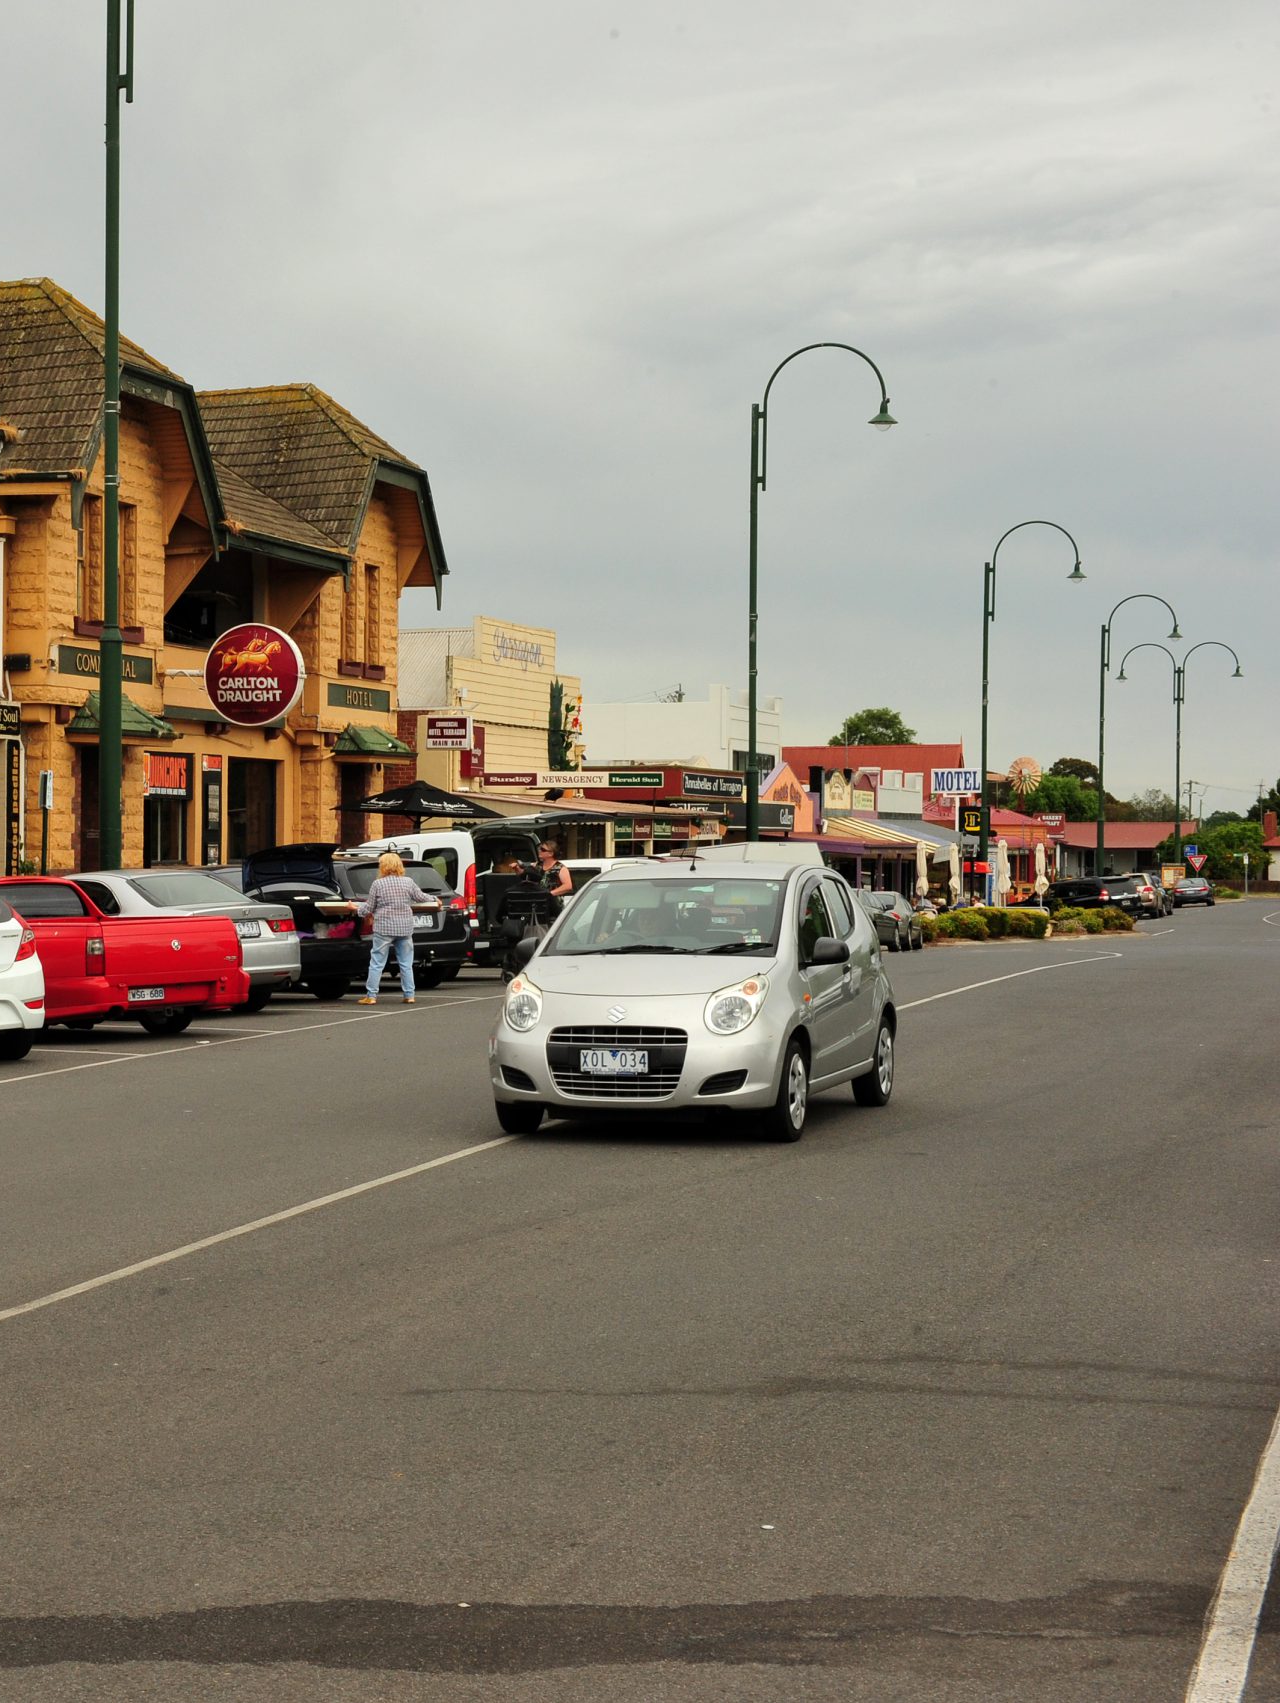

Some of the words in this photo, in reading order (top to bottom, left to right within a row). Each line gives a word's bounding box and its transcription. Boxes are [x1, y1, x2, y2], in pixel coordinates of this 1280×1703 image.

[76, 653, 137, 678] COMIAL
[219, 677, 278, 689] CARLTON
[217, 690, 282, 702] DRAUGHT
[346, 689, 373, 707] HOTEL
[3, 709, 18, 723] Soul
[149, 755, 187, 788] DUNCAN'S
[542, 775, 604, 784] NEWSAGENCY
[684, 775, 712, 791] Annabelles
[713, 777, 719, 791] of
[719, 777, 742, 794] Yarragon
[934, 771, 981, 791] MOTEL
[582, 1052, 608, 1068] XOL
[620, 1053, 647, 1068] 034
